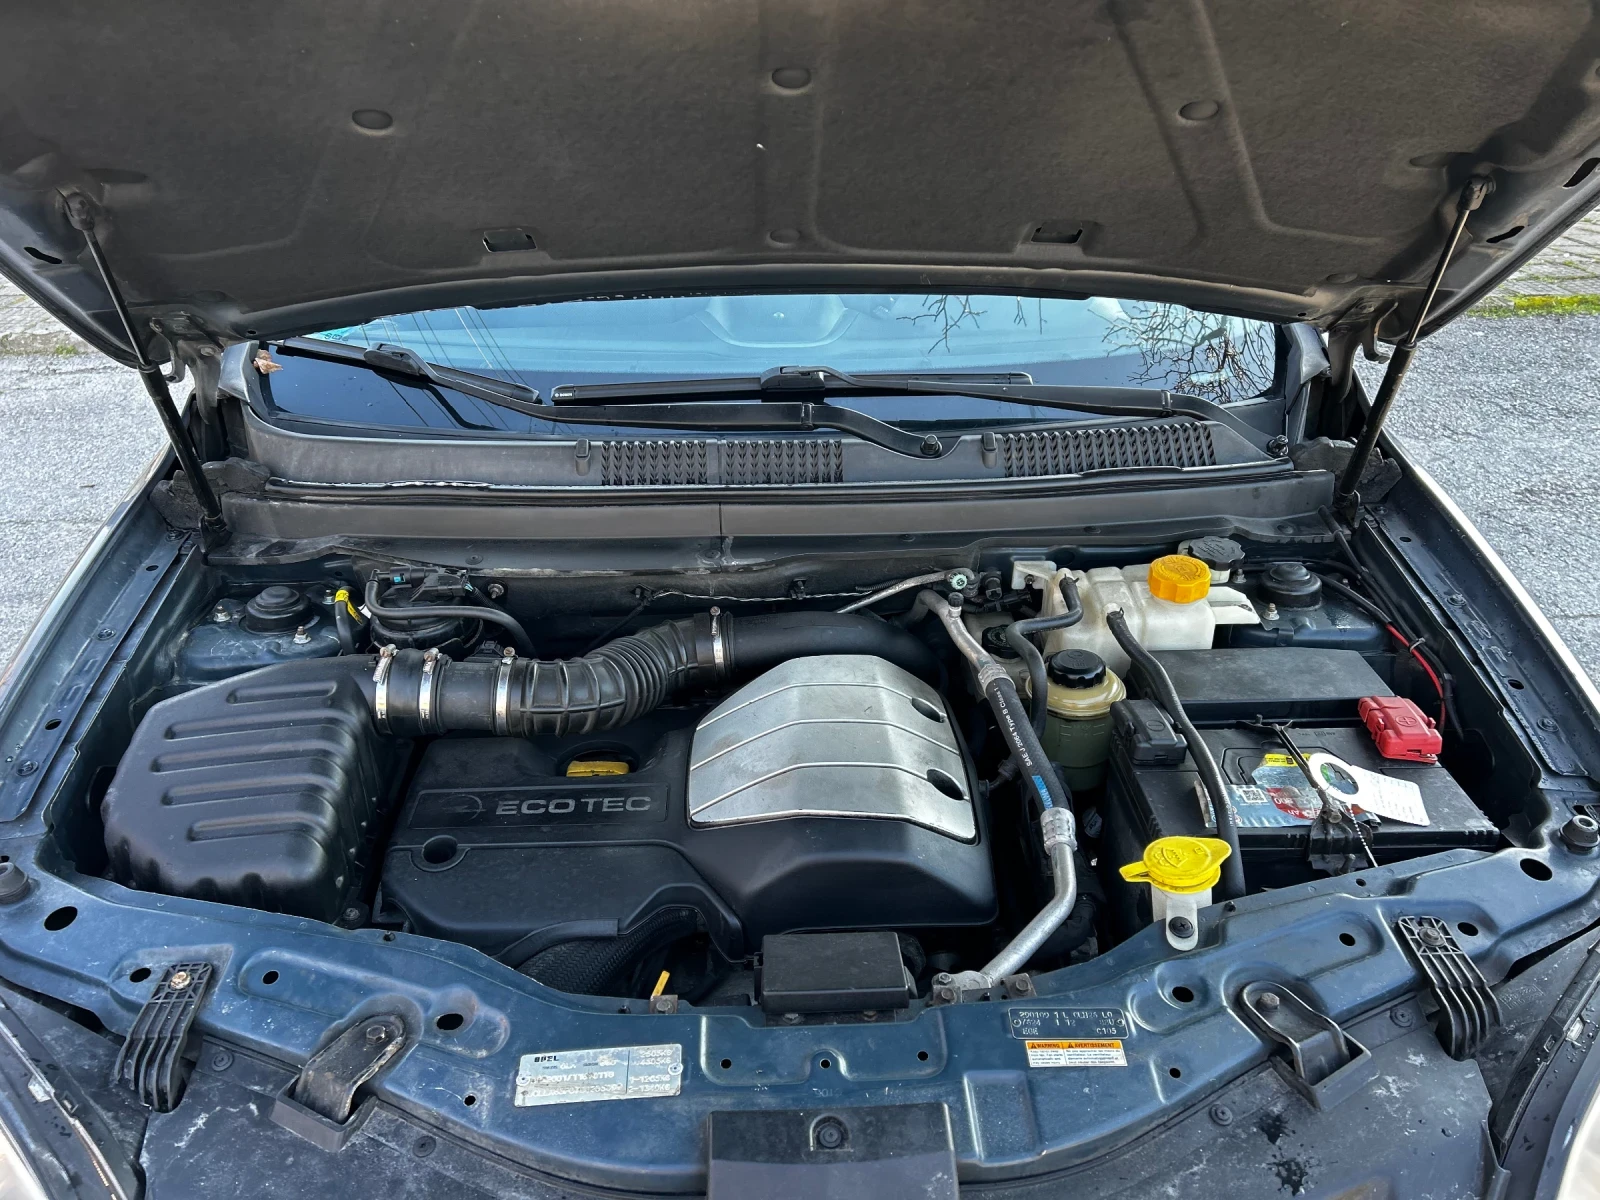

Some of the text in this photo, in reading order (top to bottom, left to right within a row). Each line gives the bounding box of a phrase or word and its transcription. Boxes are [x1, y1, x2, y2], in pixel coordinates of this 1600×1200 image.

[998, 692, 1006, 708] Class
[1006, 715, 1016, 732] Type
[1012, 732, 1024, 748] 2064
[1022, 752, 1033, 767] SAE
[496, 796, 652, 815] ECOTEC
